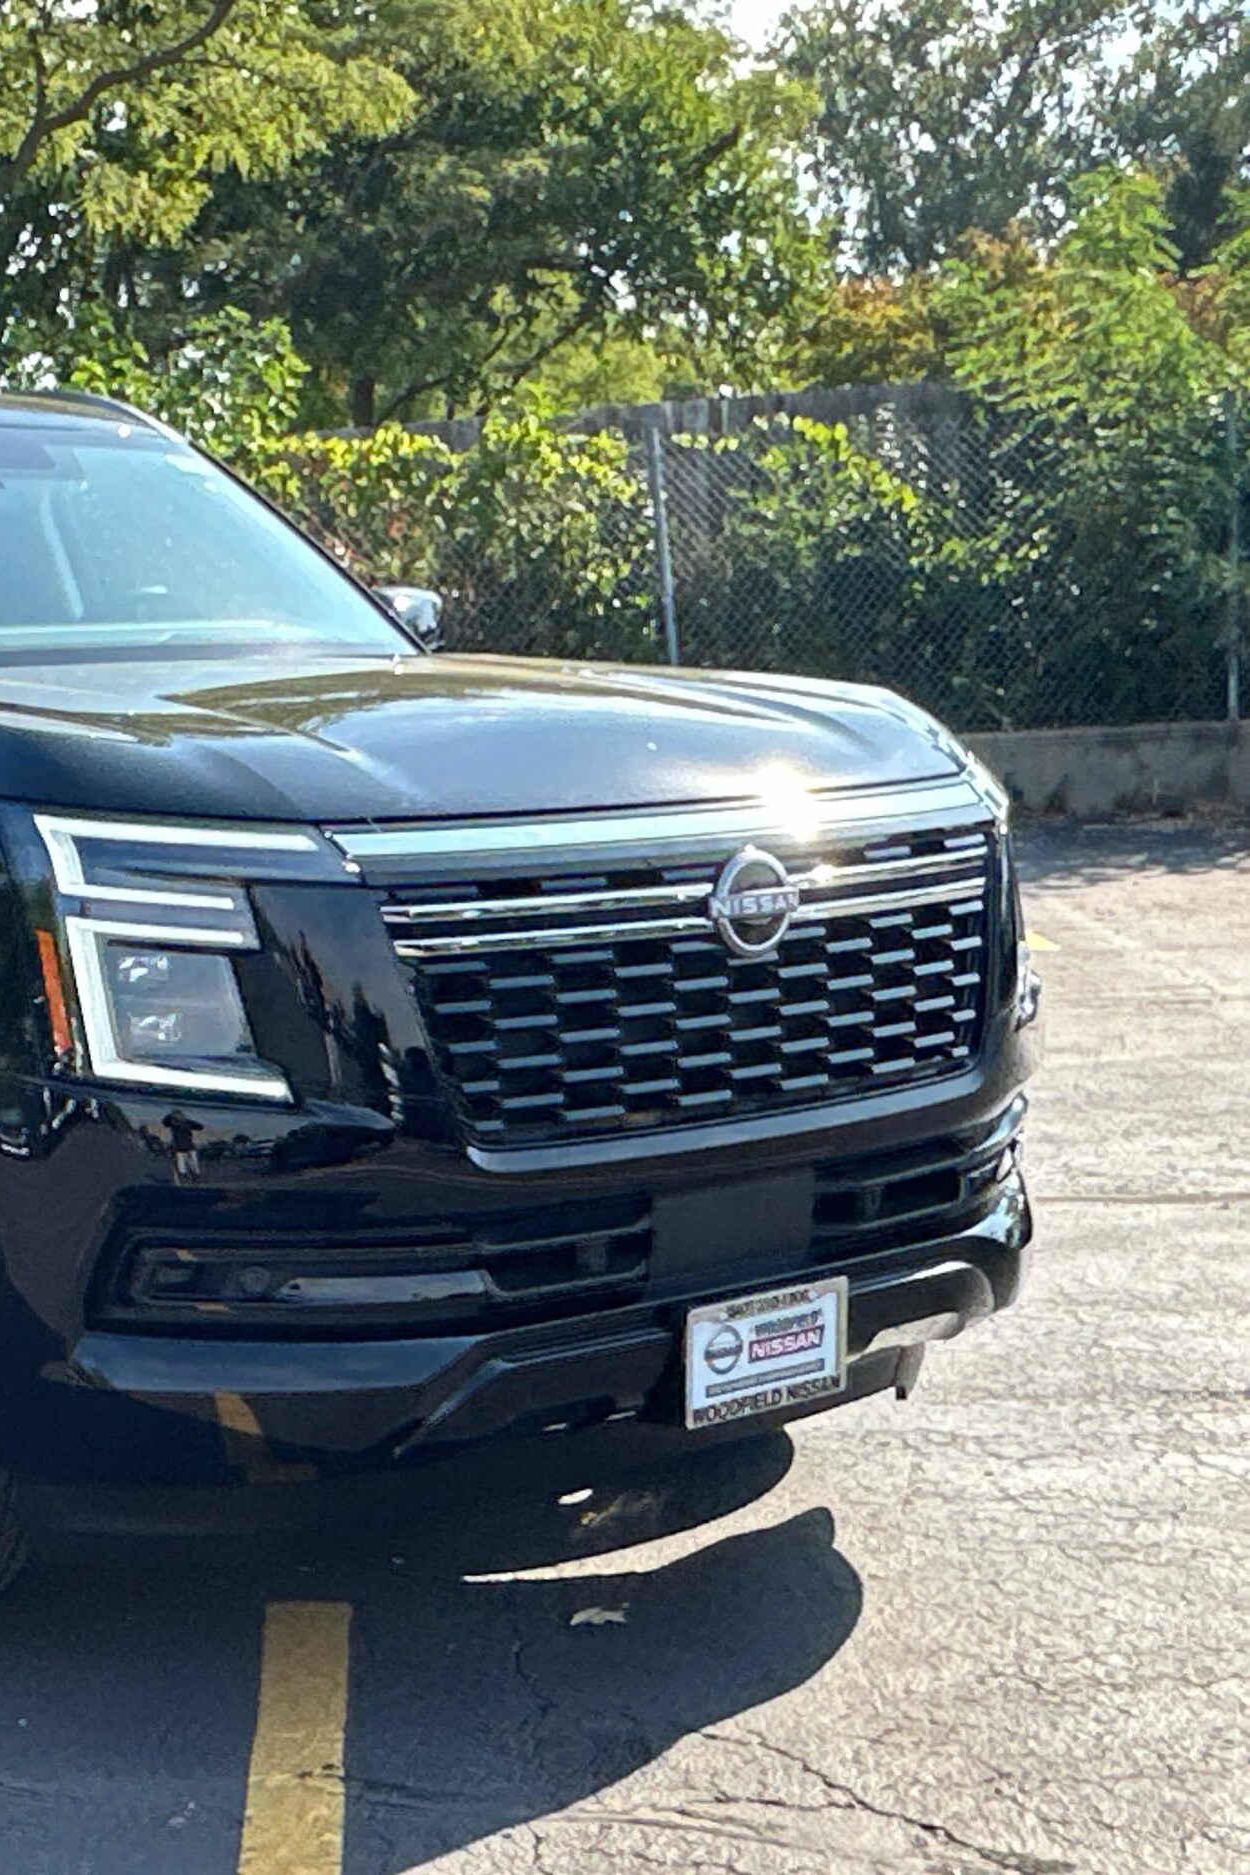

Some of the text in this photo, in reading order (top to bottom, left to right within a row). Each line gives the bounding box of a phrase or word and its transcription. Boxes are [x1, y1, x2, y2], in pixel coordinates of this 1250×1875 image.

[710, 891, 799, 918] NISSAN
[751, 1330, 820, 1358] NISSAN
[693, 1386, 783, 1424] WOODFIELD
[786, 1376, 841, 1402] NISSAN
